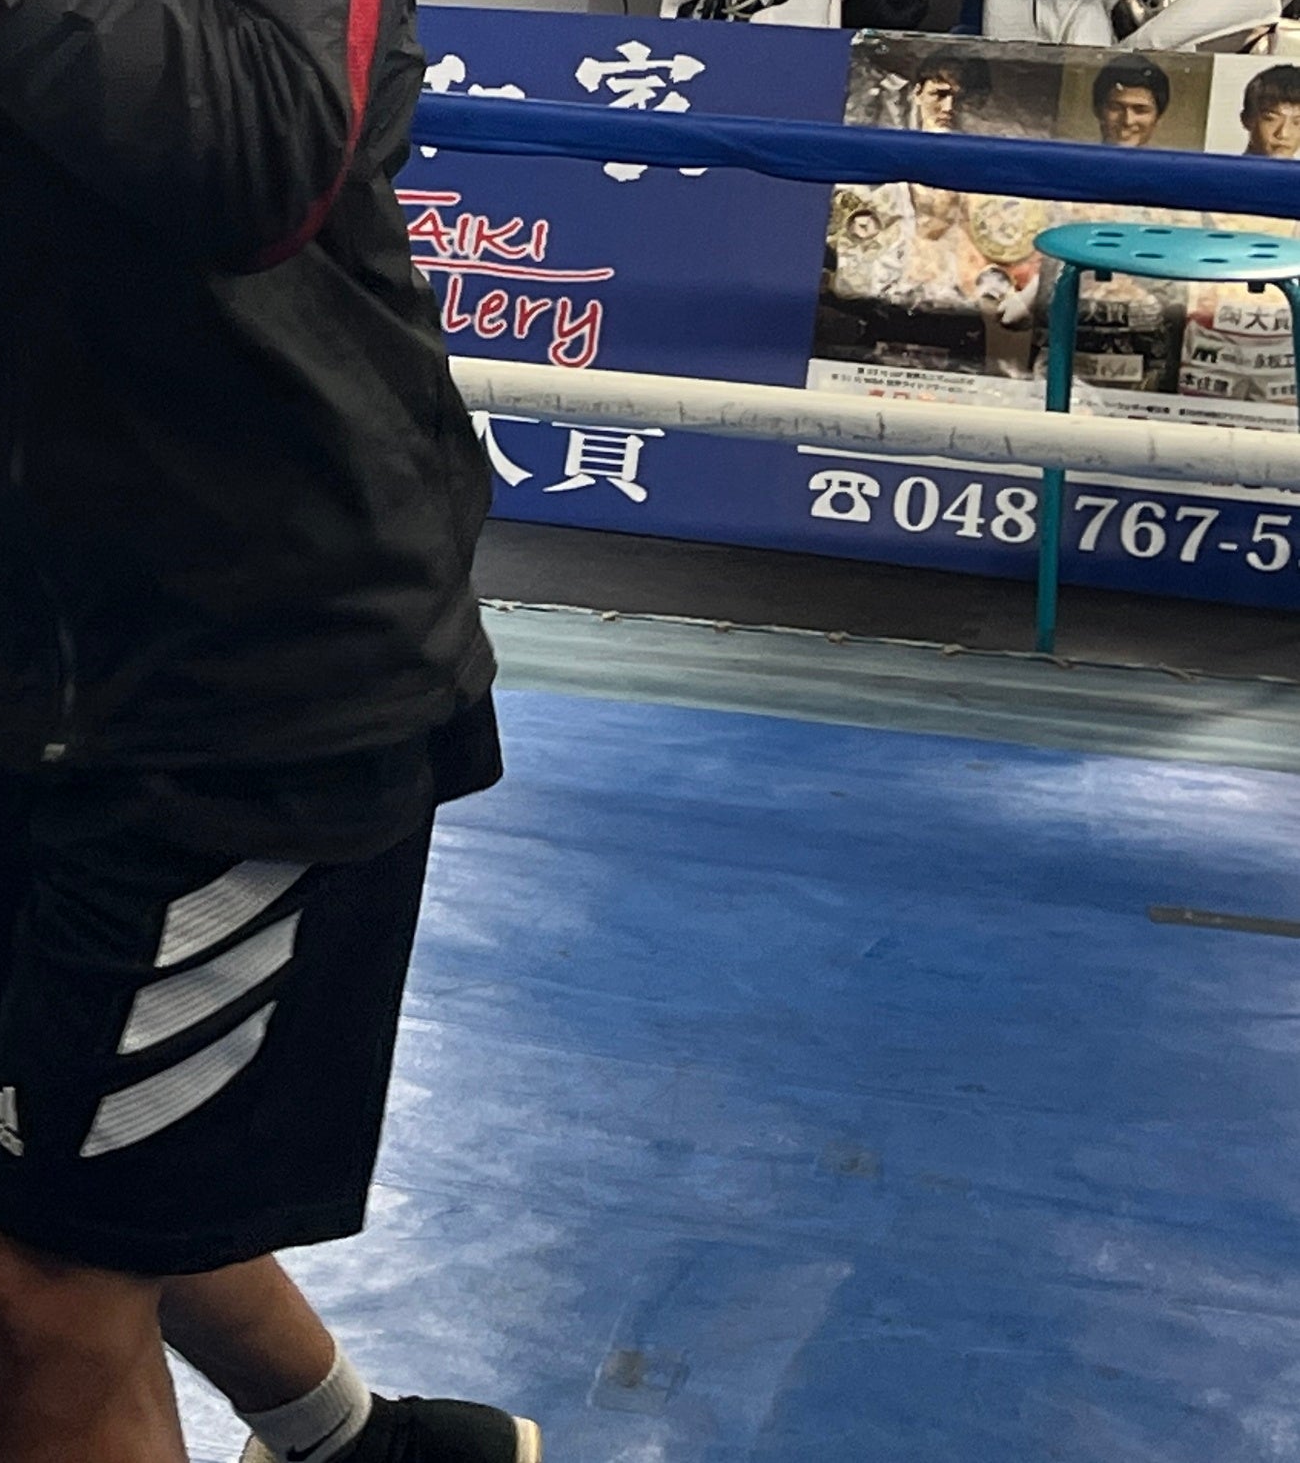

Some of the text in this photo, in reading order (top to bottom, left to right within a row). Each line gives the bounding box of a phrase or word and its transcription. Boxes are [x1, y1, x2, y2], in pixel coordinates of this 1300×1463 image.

[396, 190, 549, 262] AIKI
[440, 274, 603, 370] lery
[1073, 494, 1300, 573] 767-5
